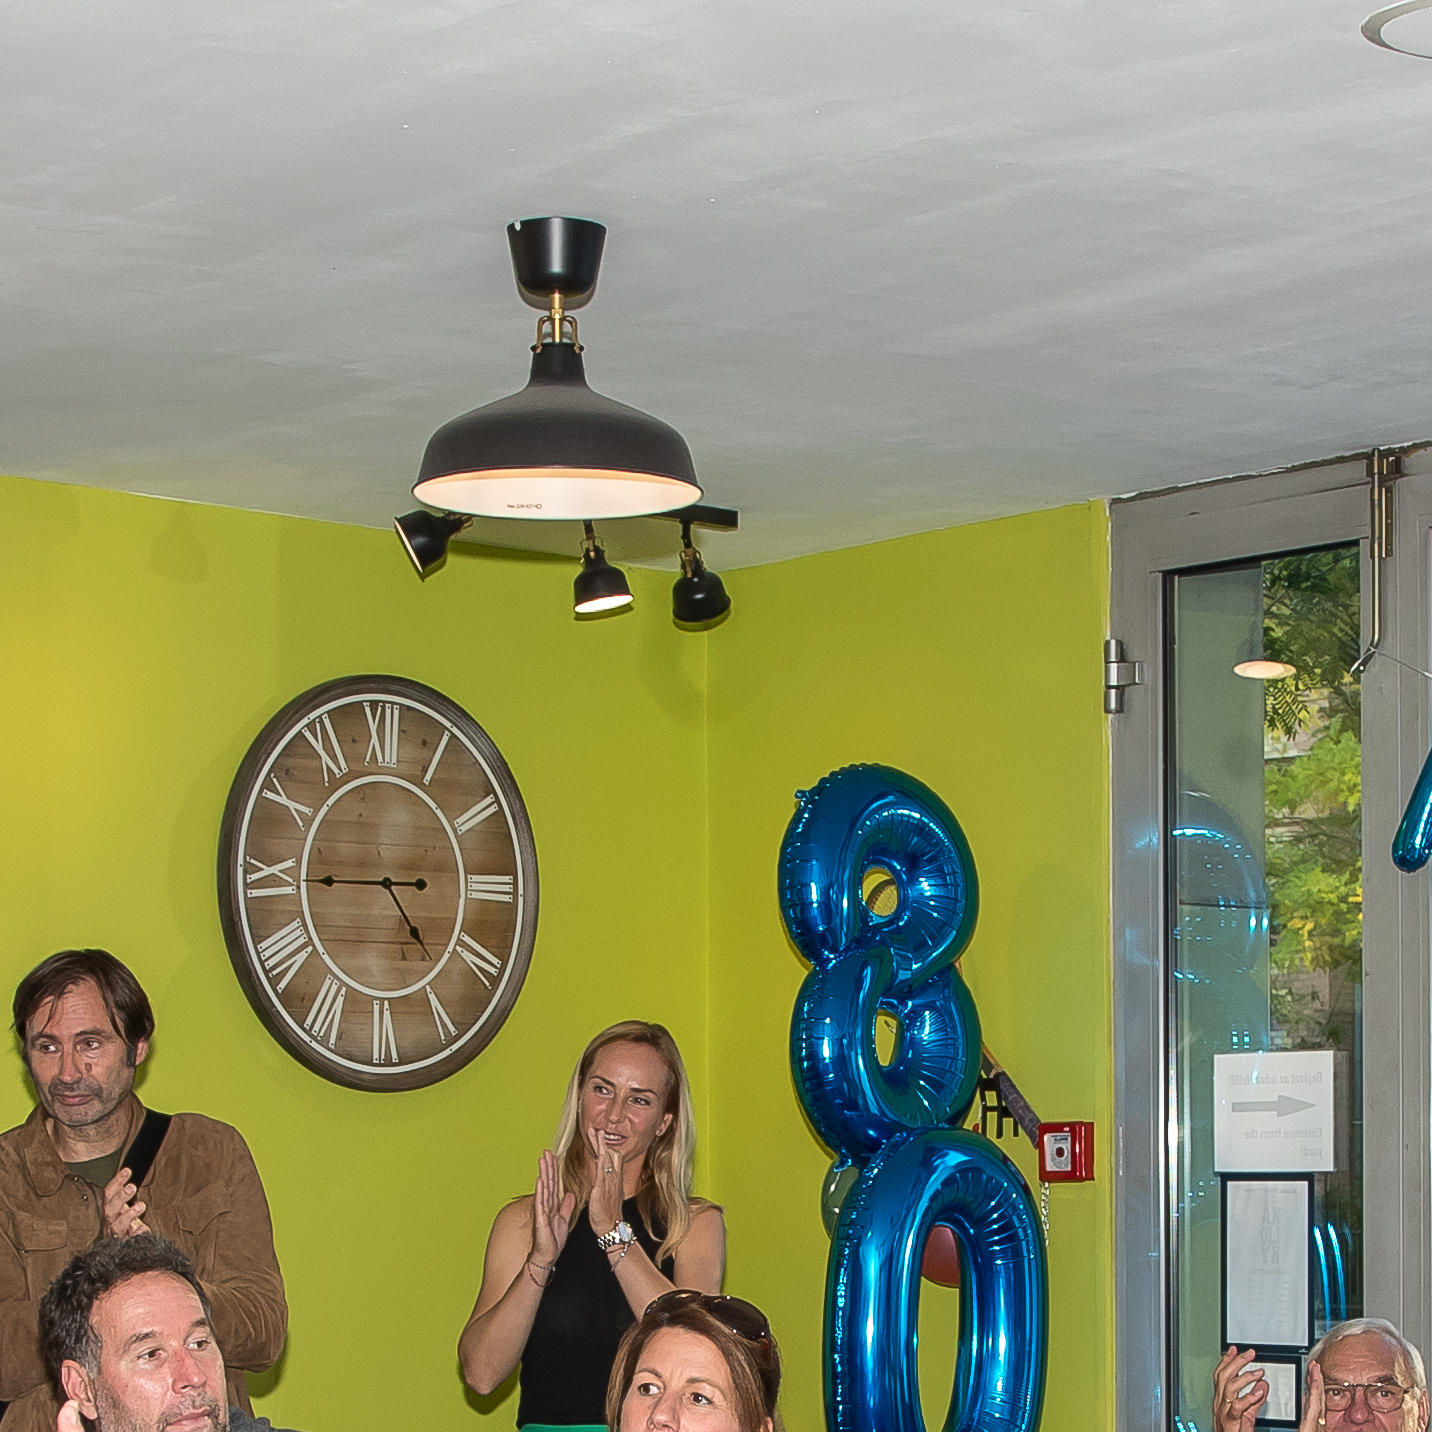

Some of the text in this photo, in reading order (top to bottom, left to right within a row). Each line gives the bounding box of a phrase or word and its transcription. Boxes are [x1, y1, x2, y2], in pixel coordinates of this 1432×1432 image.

[301, 713, 349, 787] XI
[363, 702, 400, 767] XII
[423, 730, 451, 785] I
[262, 772, 314, 831] X
[454, 794, 499, 835] II
[247, 855, 297, 898] IX
[468, 875, 514, 902] III
[257, 918, 314, 994] VIII
[455, 932, 502, 990] IV
[304, 974, 347, 1049] VII
[373, 1000, 399, 1063] VI
[426, 985, 459, 1044] V
